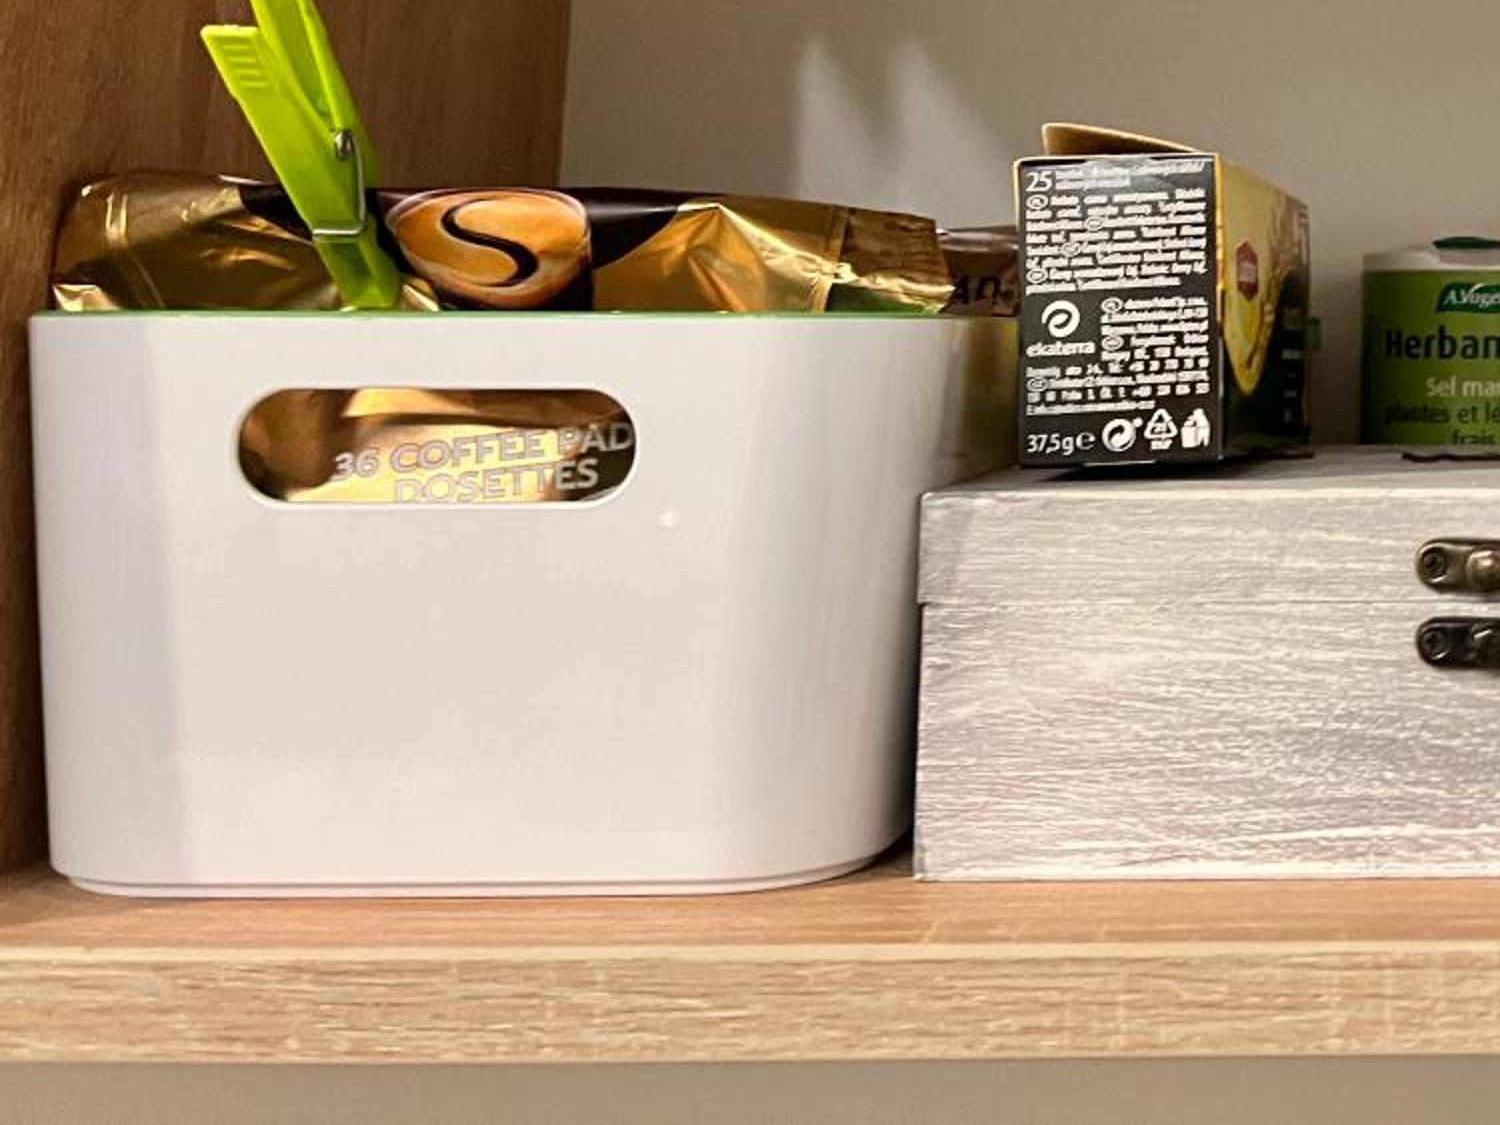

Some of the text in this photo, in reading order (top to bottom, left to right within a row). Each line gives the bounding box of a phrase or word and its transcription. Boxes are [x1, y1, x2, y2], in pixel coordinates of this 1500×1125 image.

[1025, 171, 1052, 192] 25
[1426, 376, 1456, 397] Sel
[1457, 405, 1479, 425] et
[334, 447, 381, 480] 36
[389, 427, 546, 473] COFFEE
[393, 458, 600, 503] DOSETTES
